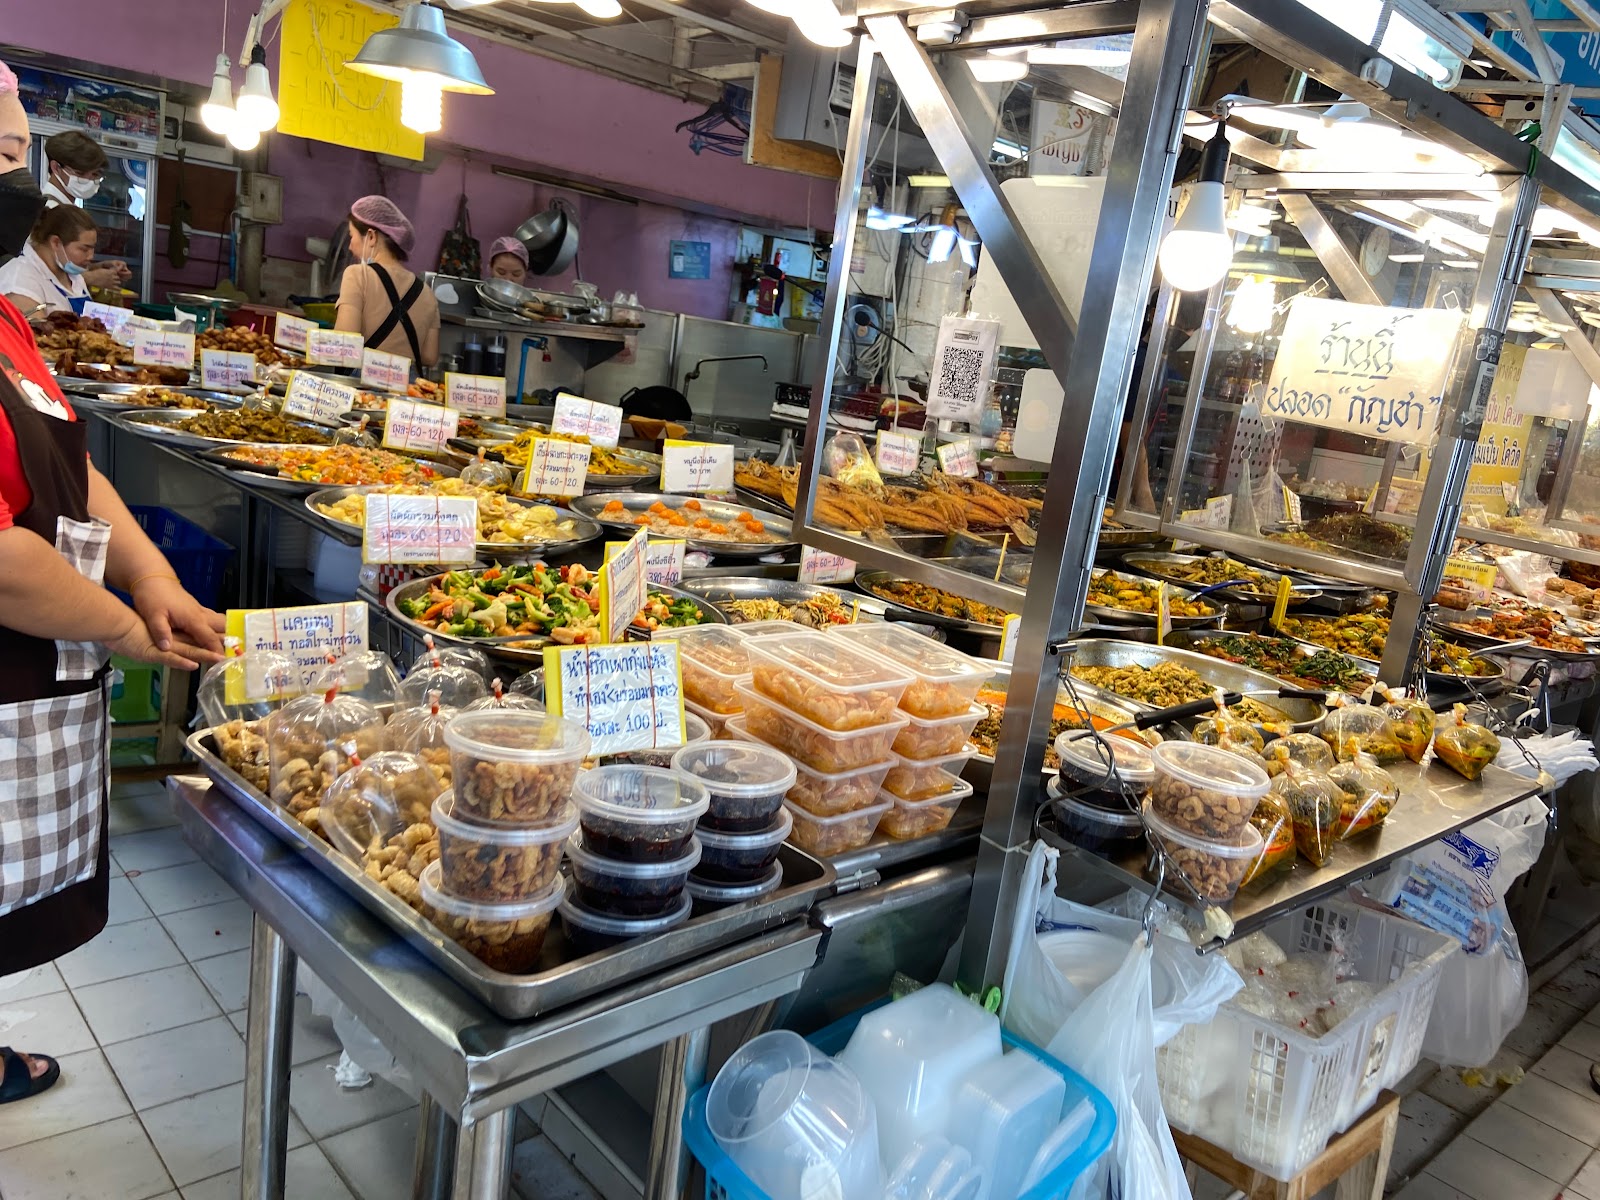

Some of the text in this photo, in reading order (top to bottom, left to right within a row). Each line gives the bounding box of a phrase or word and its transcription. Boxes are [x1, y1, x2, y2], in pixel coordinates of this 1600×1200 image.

[305, 76, 345, 113] LINE
[1320, 314, 1414, 375] ร้านนี้
[467, 393, 499, 406] 60-120
[1266, 377, 1332, 419] ปลอด
[1484, 393, 1500, 425] ป็น
[392, 423, 445, 441] ถุงละ 60-120
[683, 455, 718, 467] หมูนึ่งไข่เค็ม
[1501, 438, 1521, 467] โควิด
[282, 613, 335, 634] แคบหมู
[626, 714, 651, 732] 100
